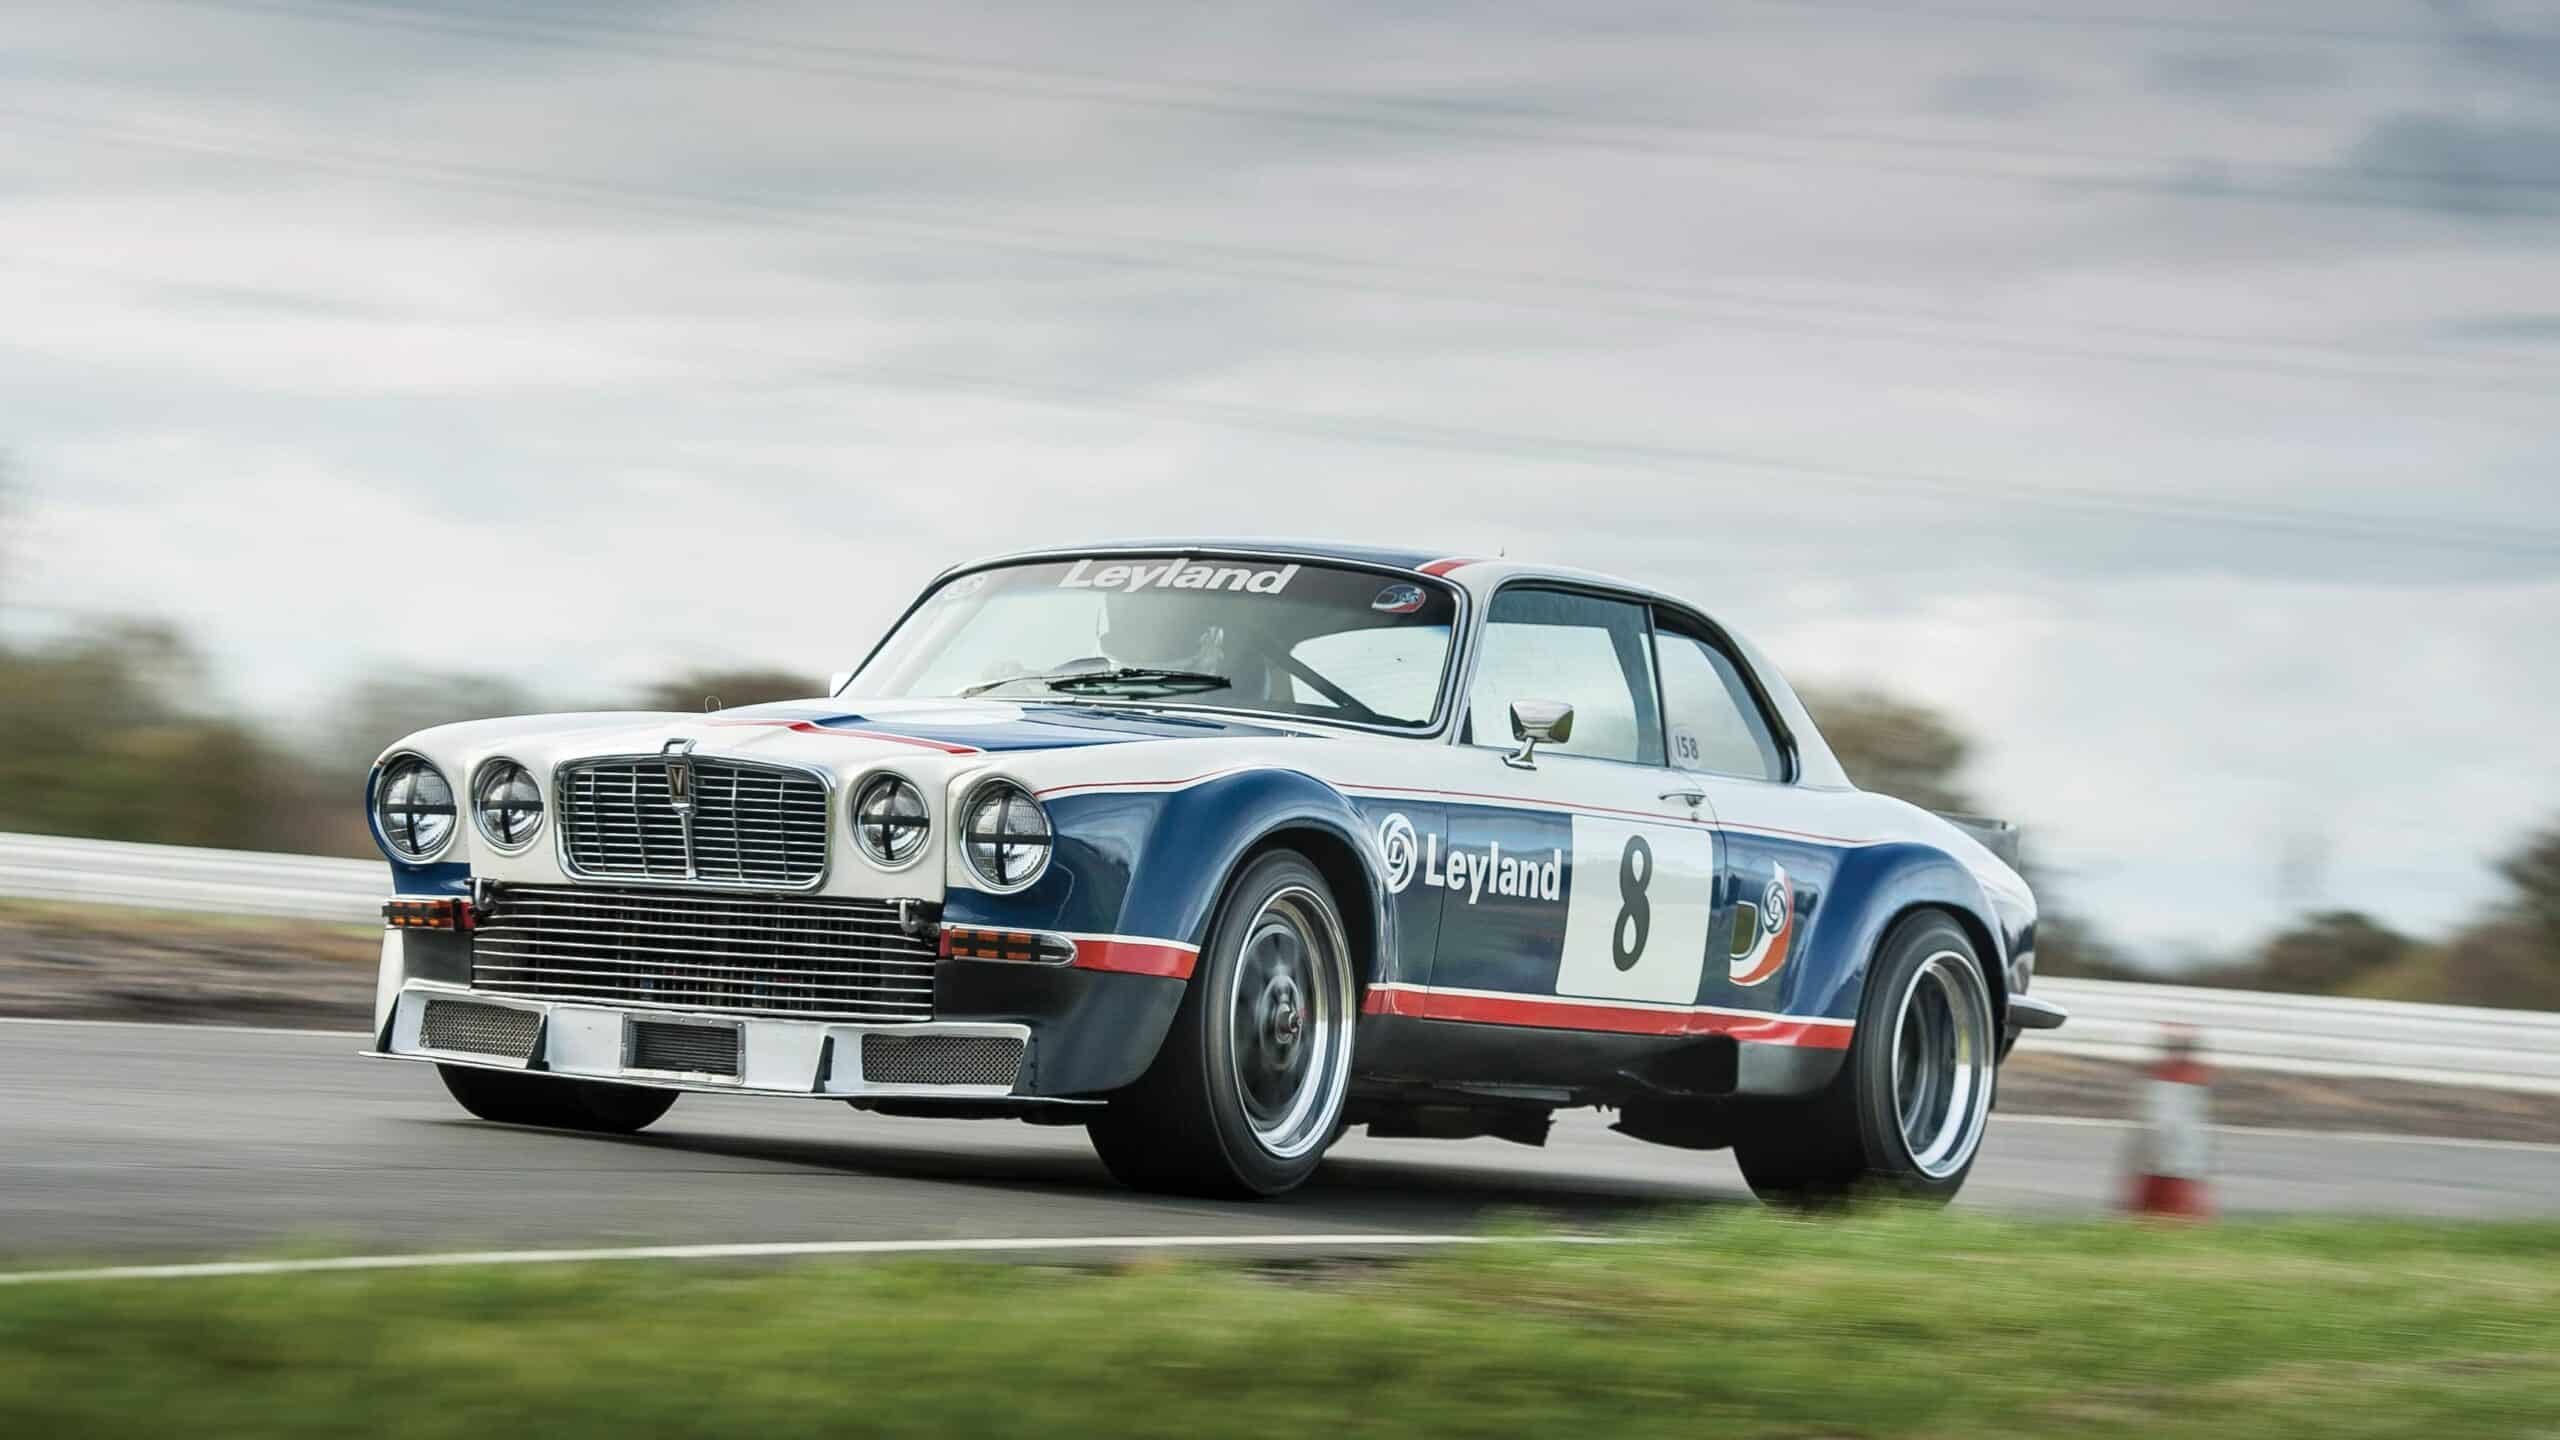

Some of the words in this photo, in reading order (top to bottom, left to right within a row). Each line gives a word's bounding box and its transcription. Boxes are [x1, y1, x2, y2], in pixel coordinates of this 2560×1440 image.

[1058, 558, 1301, 594] Leyland
[1675, 735, 1699, 760] 158
[1425, 832, 1562, 905] Leyland
[1612, 835, 1654, 972] 8
